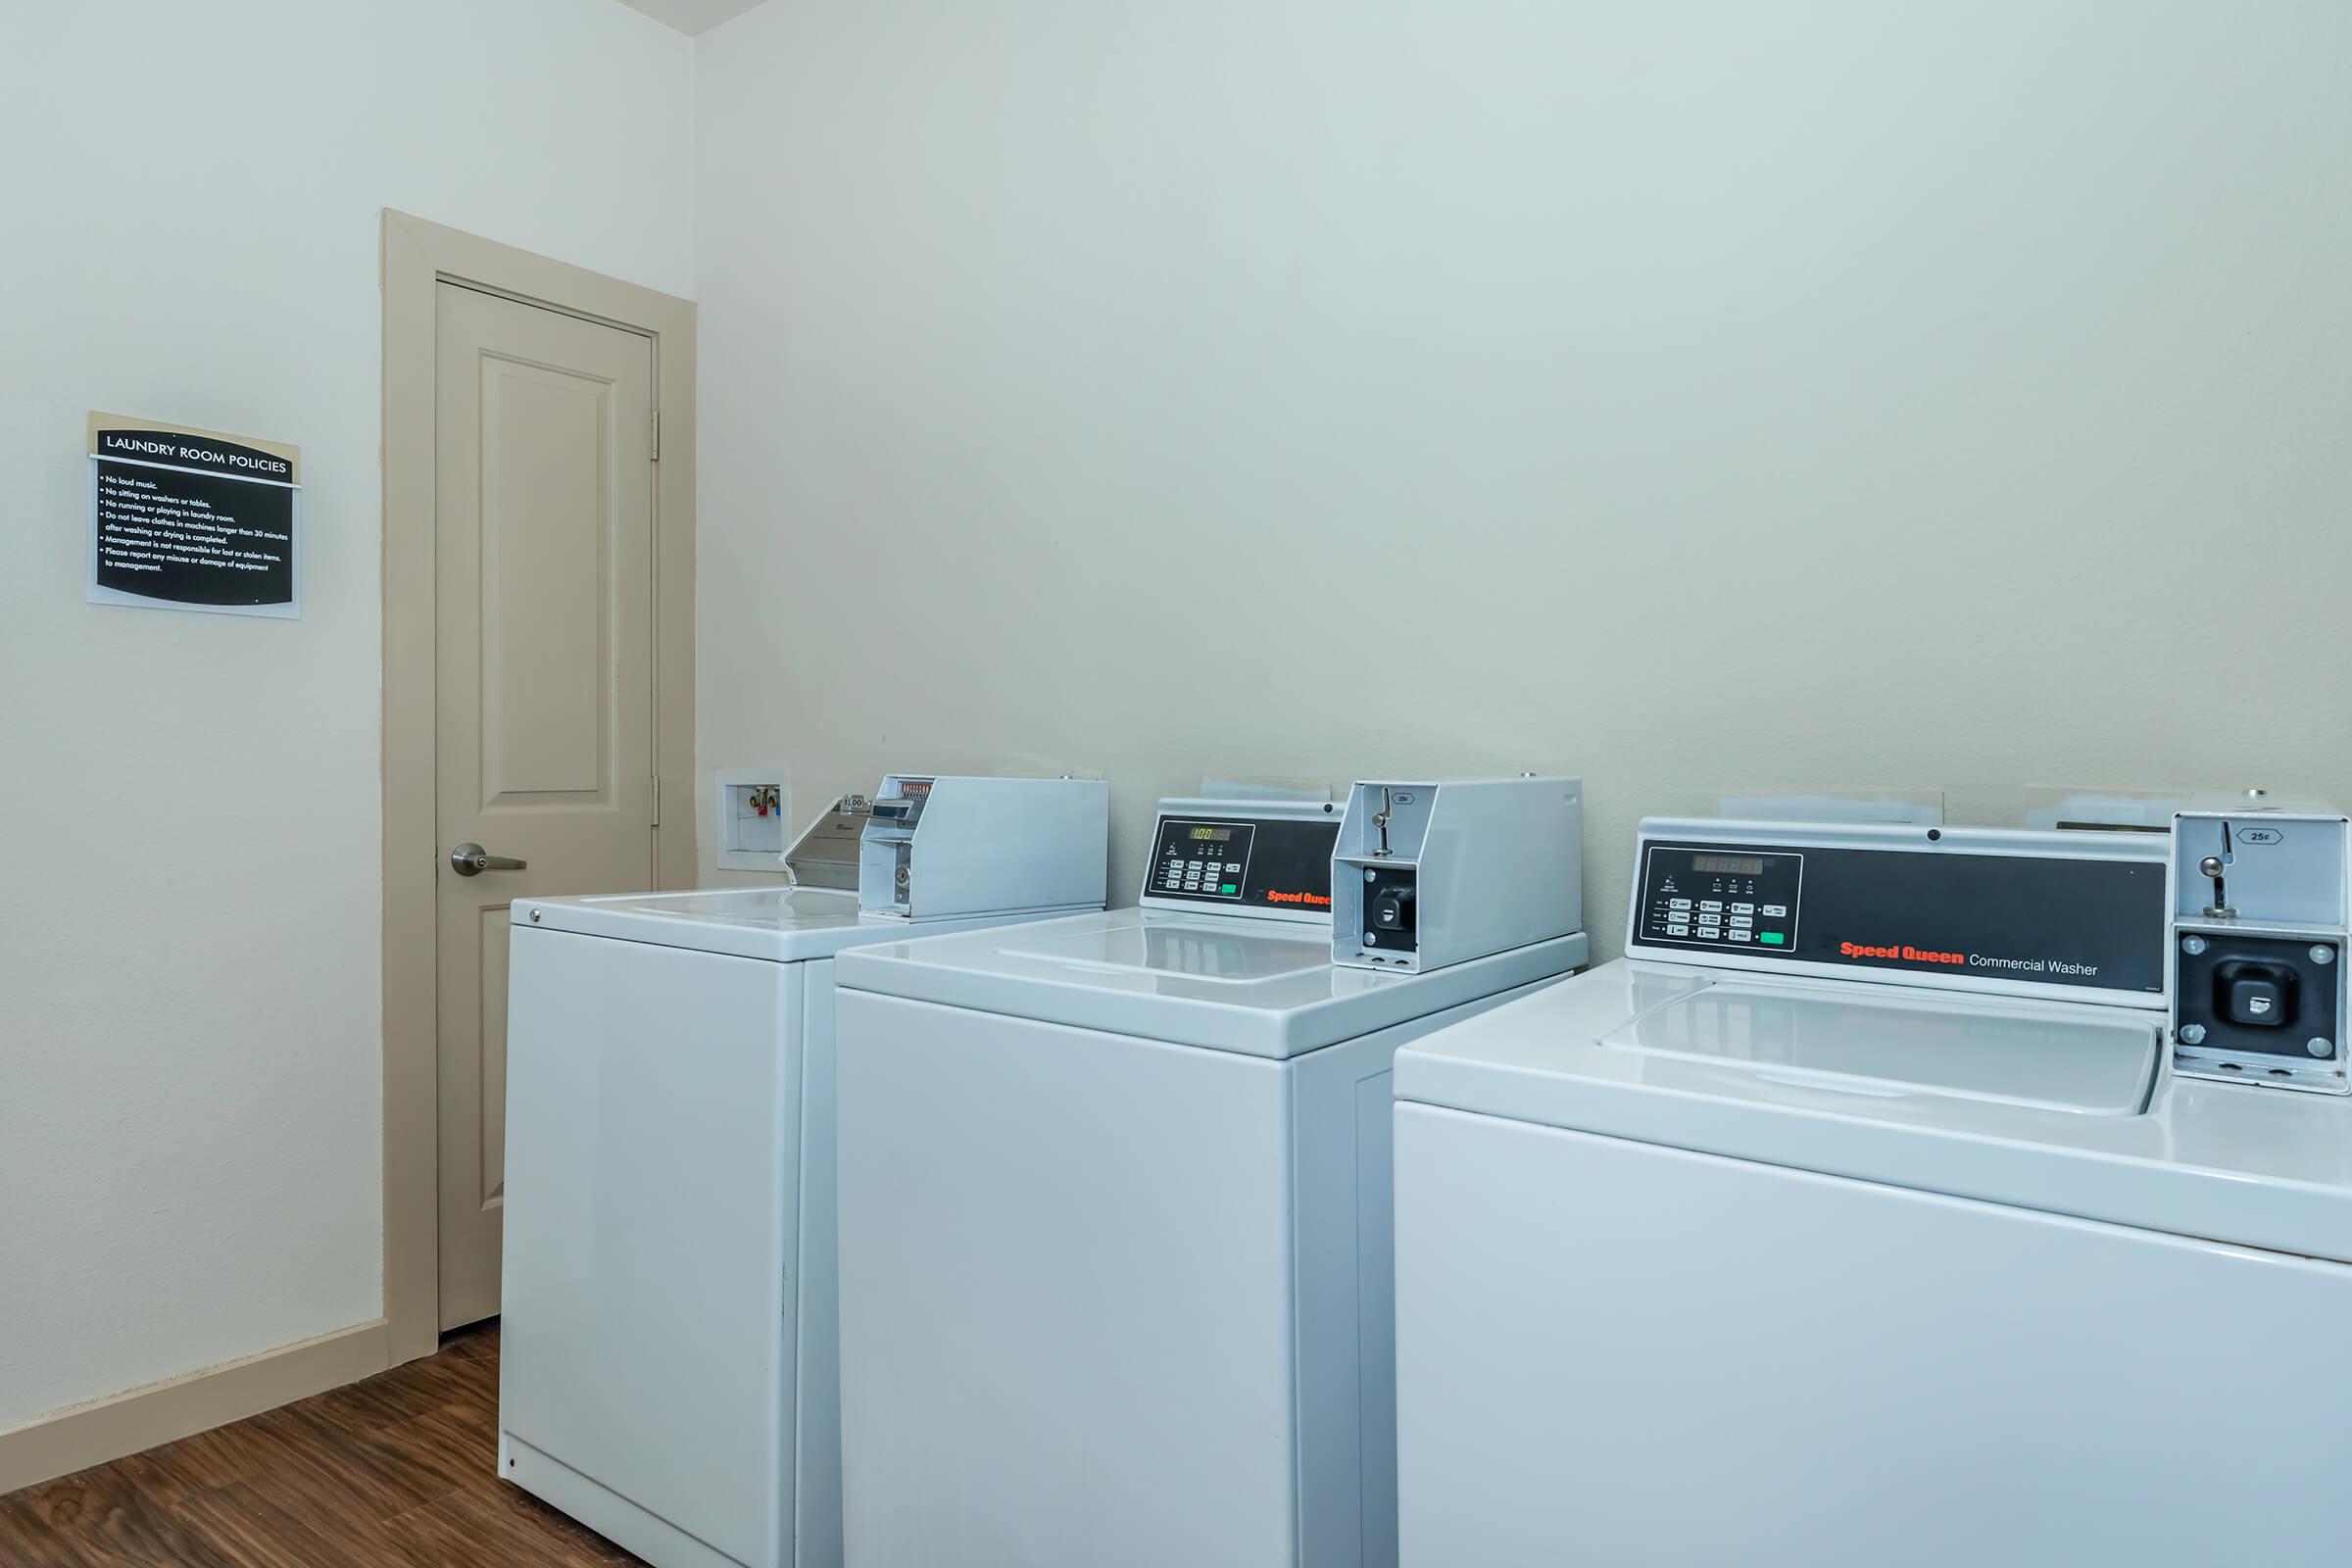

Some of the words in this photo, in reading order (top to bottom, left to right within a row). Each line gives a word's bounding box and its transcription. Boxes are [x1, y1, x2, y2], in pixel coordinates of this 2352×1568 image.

[107, 436, 175, 456] LAUNDRY
[179, 447, 225, 464] ROOM
[228, 455, 286, 473] POLICIES
[105, 475, 117, 484] No
[118, 476, 134, 486] loud
[135, 481, 158, 490] music.
[105, 487, 117, 496] No
[118, 490, 140, 500] sitting
[151, 495, 179, 504] washers
[189, 499, 212, 509] tables.
[118, 503, 146, 513] running
[156, 506, 181, 517] playing
[190, 510, 215, 521] laundry
[105, 511, 117, 519] Do
[130, 514, 150, 523] leave
[151, 516, 175, 527] clothes
[184, 521, 216, 532] machines
[217, 524, 238, 535] longer
[238, 527, 254, 536] than
[254, 529, 264, 538] 30
[105, 522, 122, 532] after
[122, 526, 153, 537] washing
[163, 529, 184, 540] drying
[192, 535, 228, 545] completed.
[105, 535, 152, 547] Management
[211, 546, 221, 555] for
[221, 548, 234, 557] lost
[242, 551, 262, 560] stolen
[105, 547, 128, 557] Please
[128, 551, 151, 560] report
[152, 553, 166, 563] any
[166, 554, 190, 564] misuse
[199, 557, 226, 567] damage
[235, 562, 269, 571] equipment
[114, 561, 163, 572] management.
[1268, 890, 1302, 902] Speed
[1303, 893, 1332, 906] Quee
[1840, 942, 1899, 958] Speed
[1902, 946, 1964, 964] Queen
[1969, 954, 2045, 972] Commercial
[2048, 960, 2098, 976] Washer
